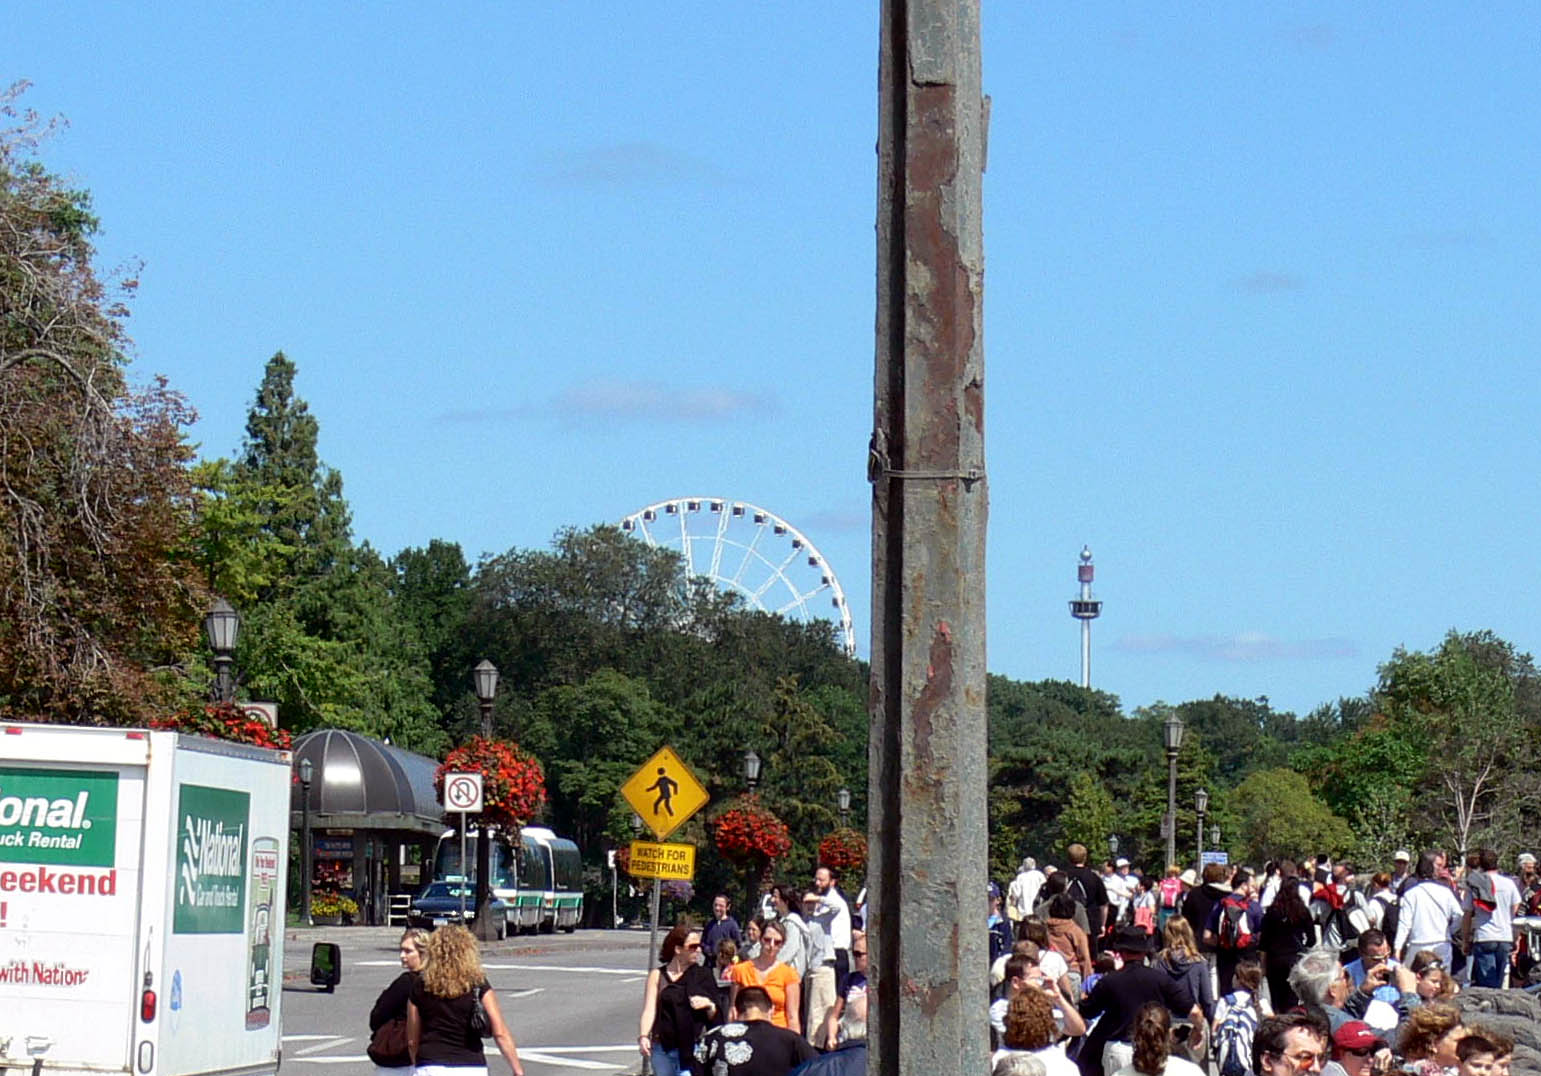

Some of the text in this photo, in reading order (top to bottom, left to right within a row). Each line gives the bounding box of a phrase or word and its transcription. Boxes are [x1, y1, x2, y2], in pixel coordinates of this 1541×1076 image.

[28, 831, 82, 849] Rental
[199, 819, 243, 876] National
[637, 848, 686, 861] WATCH FOR
[632, 860, 689, 874] PEDESTRIANS
[0, 867, 116, 895] eekend
